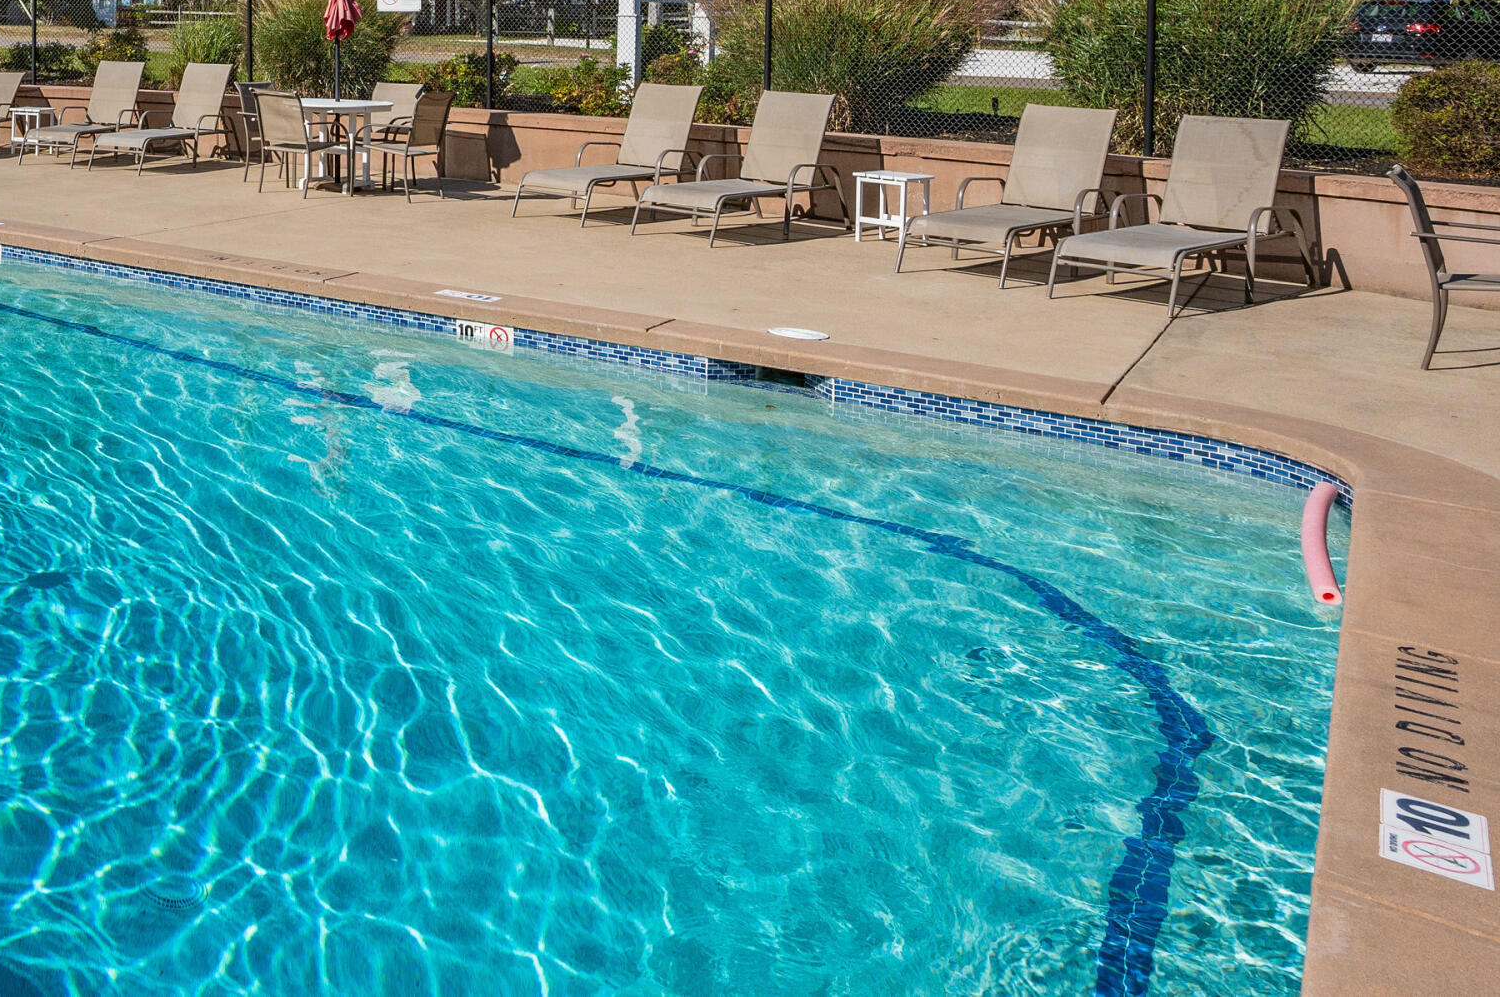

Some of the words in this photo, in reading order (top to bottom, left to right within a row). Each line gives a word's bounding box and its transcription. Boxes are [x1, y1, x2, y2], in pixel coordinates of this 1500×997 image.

[458, 323, 474, 337] 10
[474, 325, 483, 333] FT
[1395, 646, 1466, 746] DIVING
[1396, 747, 1470, 794] NO
[1396, 798, 1470, 840] 10
